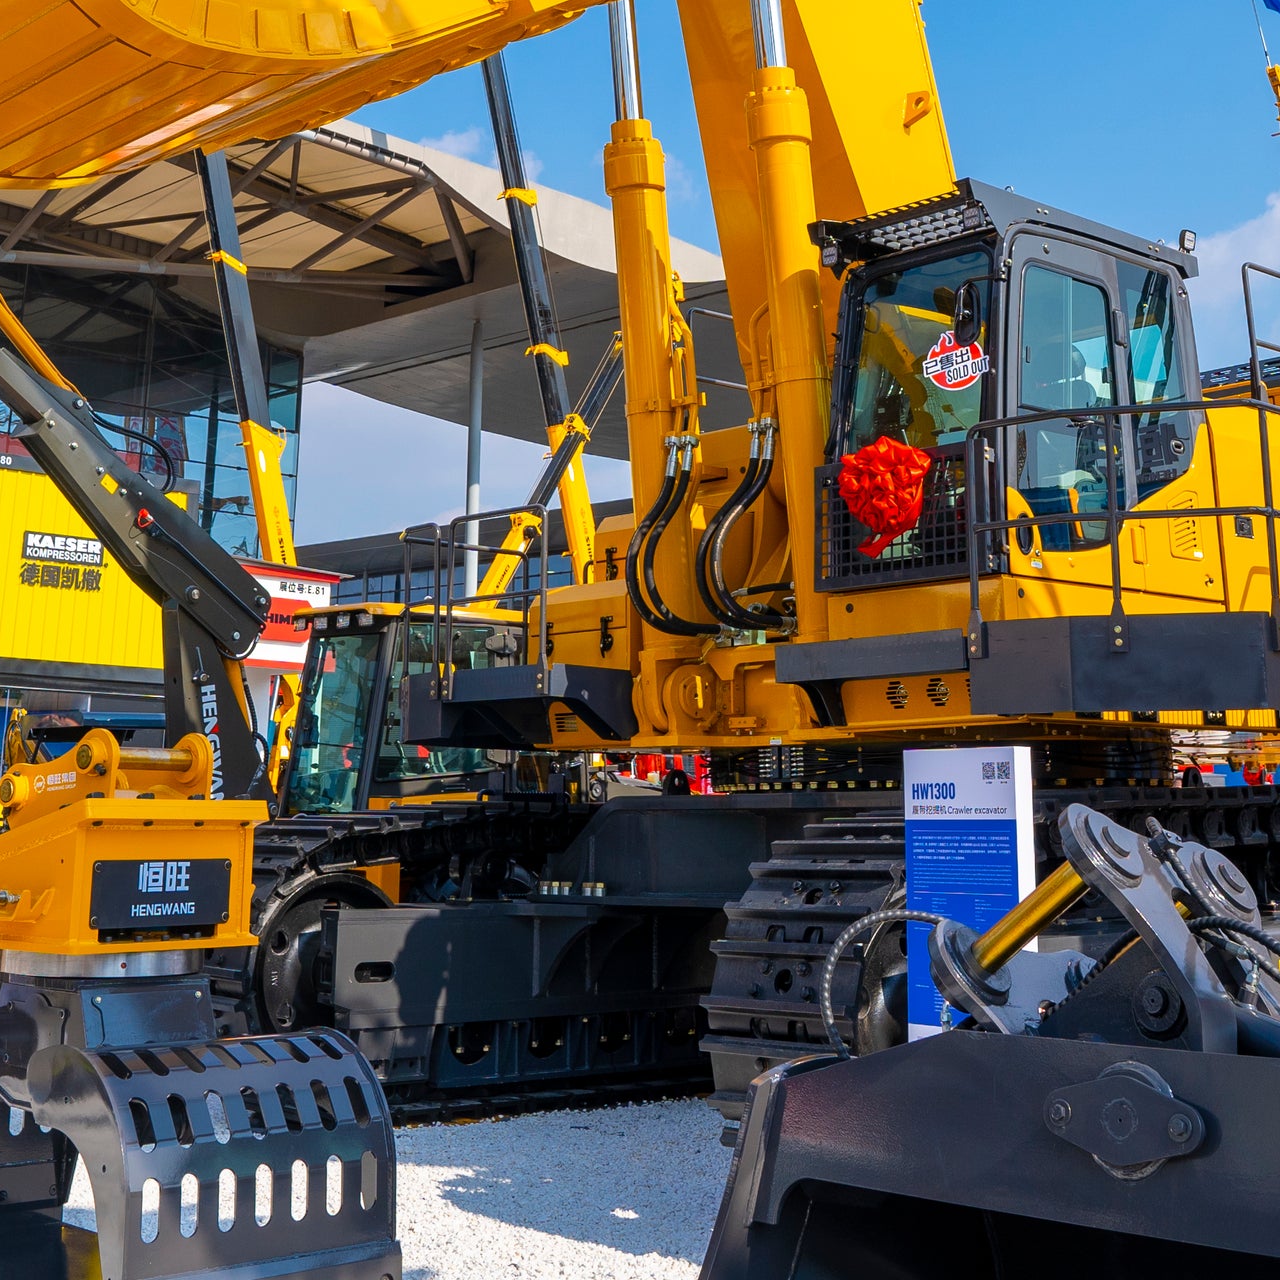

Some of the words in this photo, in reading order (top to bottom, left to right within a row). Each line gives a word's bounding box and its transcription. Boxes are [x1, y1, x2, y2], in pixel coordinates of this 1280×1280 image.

[924, 348, 970, 376] 已售出
[947, 364, 969, 383] SOLD
[970, 357, 988, 376] OUT
[27, 533, 101, 554] KAESER
[26, 546, 101, 564] KOMPRESSOREN
[20, 562, 102, 592] 德国凯撒
[911, 782, 956, 800] HW1300
[947, 805, 973, 815] Crawler
[974, 806, 1007, 815] excavator
[138, 861, 191, 893] 恒旺
[131, 902, 196, 917] HENGWANG
